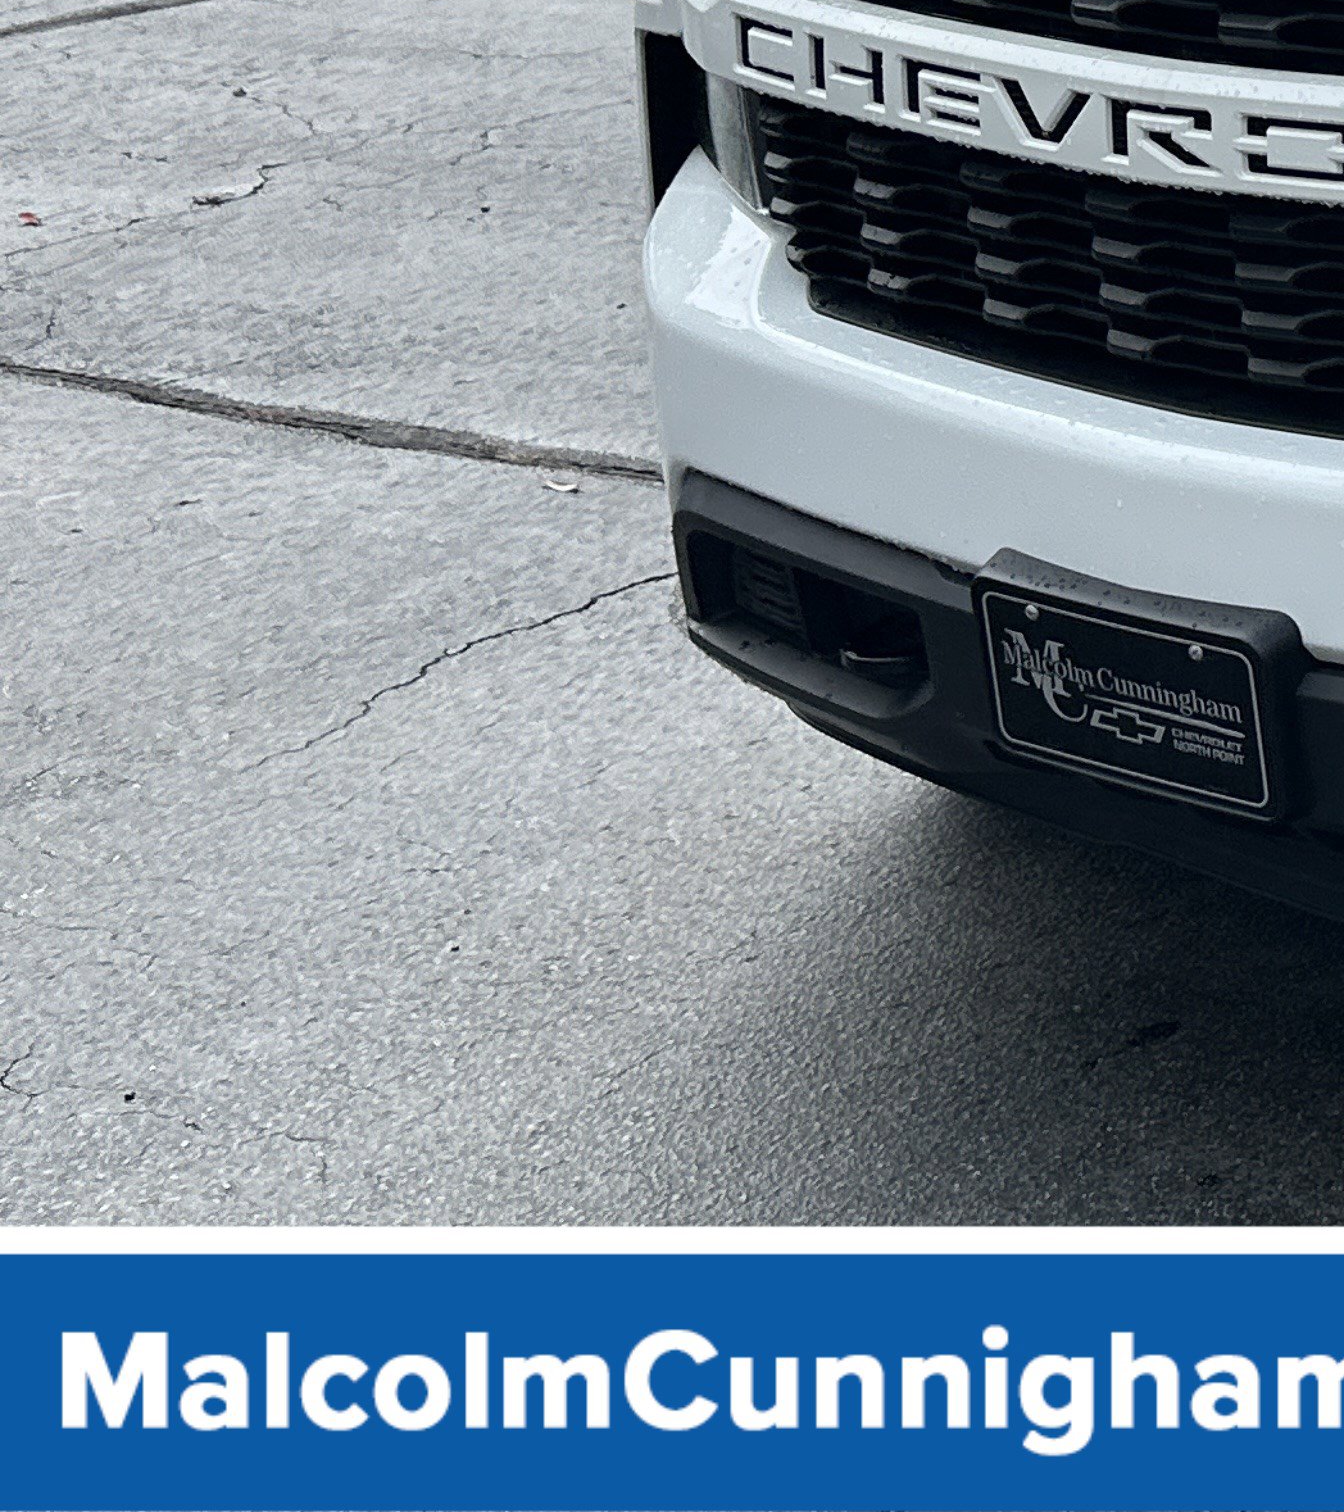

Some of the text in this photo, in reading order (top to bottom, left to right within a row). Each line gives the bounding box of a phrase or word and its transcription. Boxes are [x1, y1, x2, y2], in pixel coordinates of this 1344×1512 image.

[1001, 639, 1243, 724] Malcolm Cunningham
[1171, 727, 1242, 752] CHEVROLET
